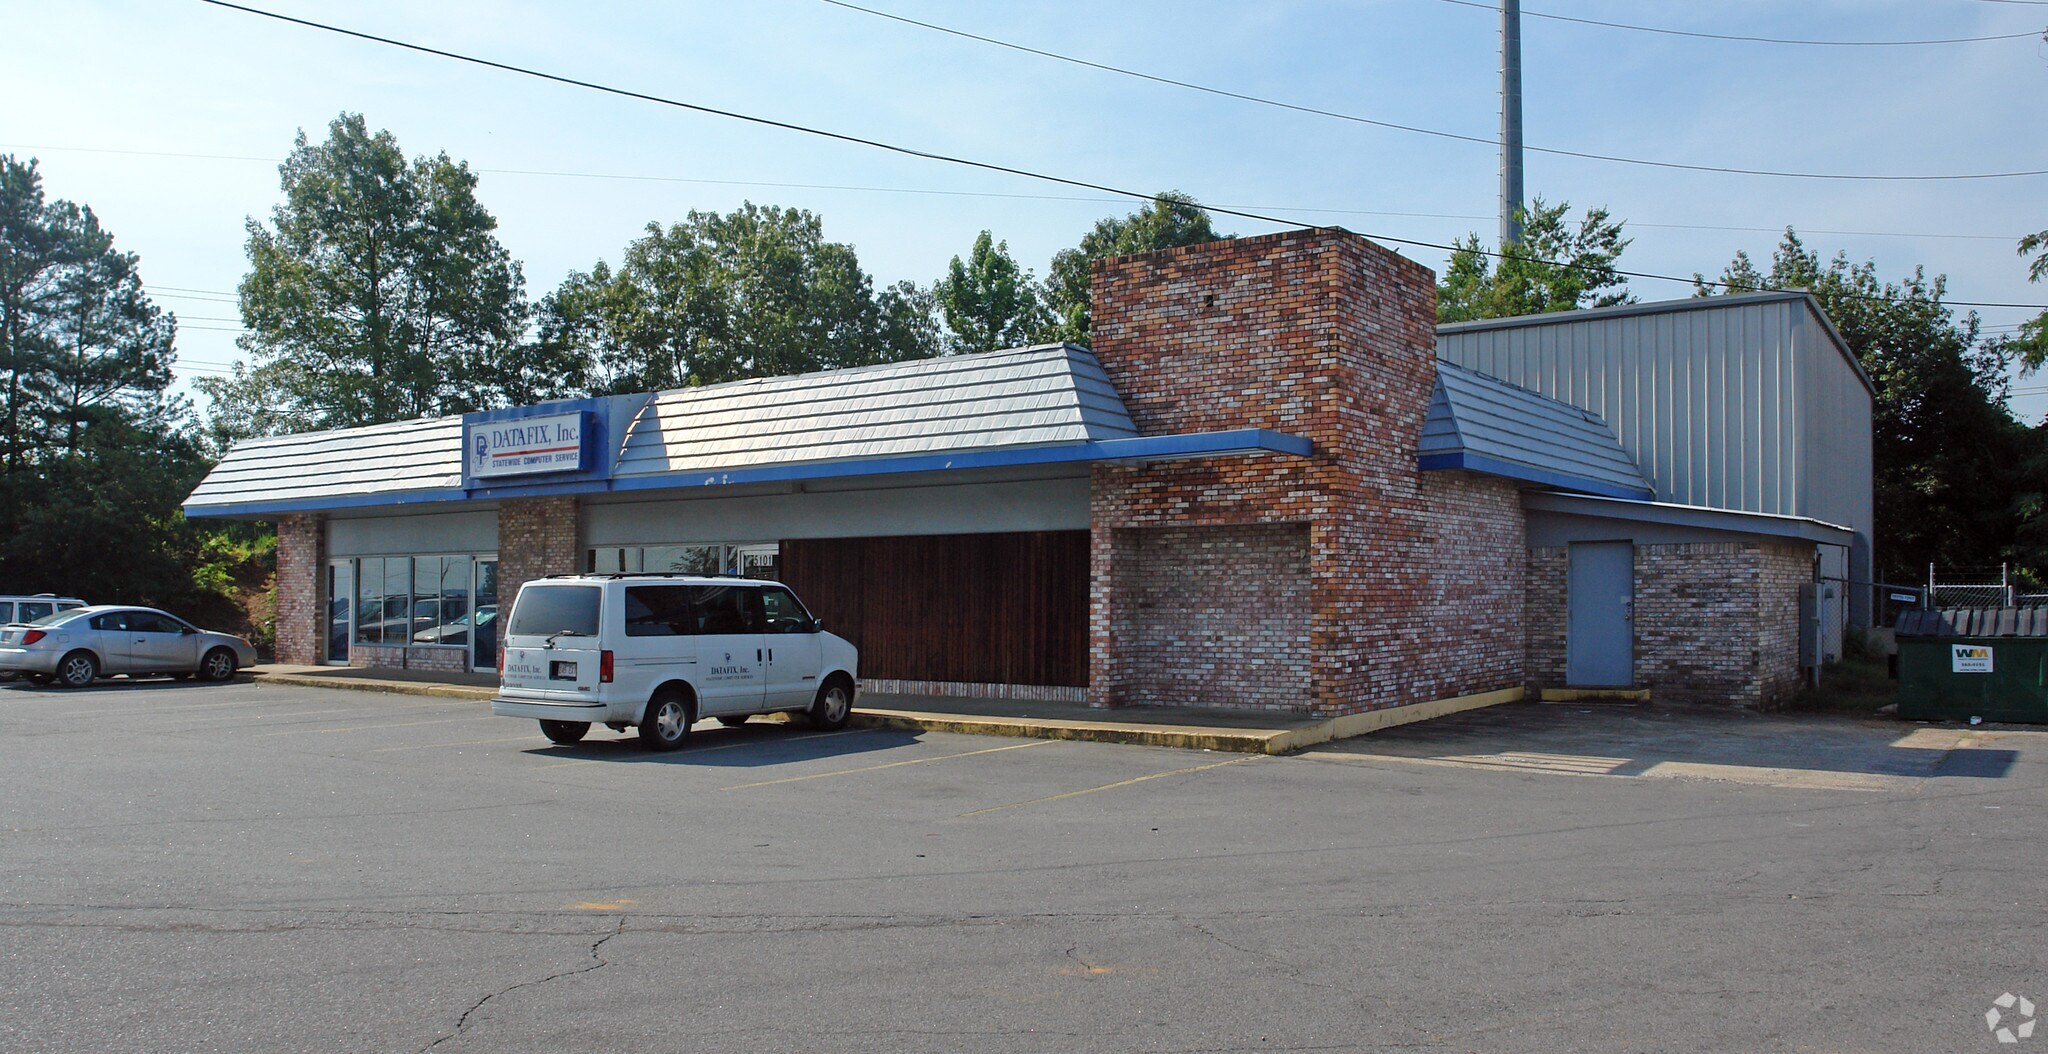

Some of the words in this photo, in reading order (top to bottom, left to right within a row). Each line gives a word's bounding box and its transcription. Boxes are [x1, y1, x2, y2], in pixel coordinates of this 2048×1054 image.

[493, 425, 551, 449] DATAFIX,
[557, 423, 579, 442] Inc.
[492, 457, 521, 468] STATEWIDE
[524, 455, 552, 465] COMPUTER
[555, 452, 578, 463] SERVICE
[754, 555, 771, 566] 5101
[1956, 649, 1988, 657] WM
[532, 665, 542, 673] Inc.
[740, 665, 750, 673] Inc.
